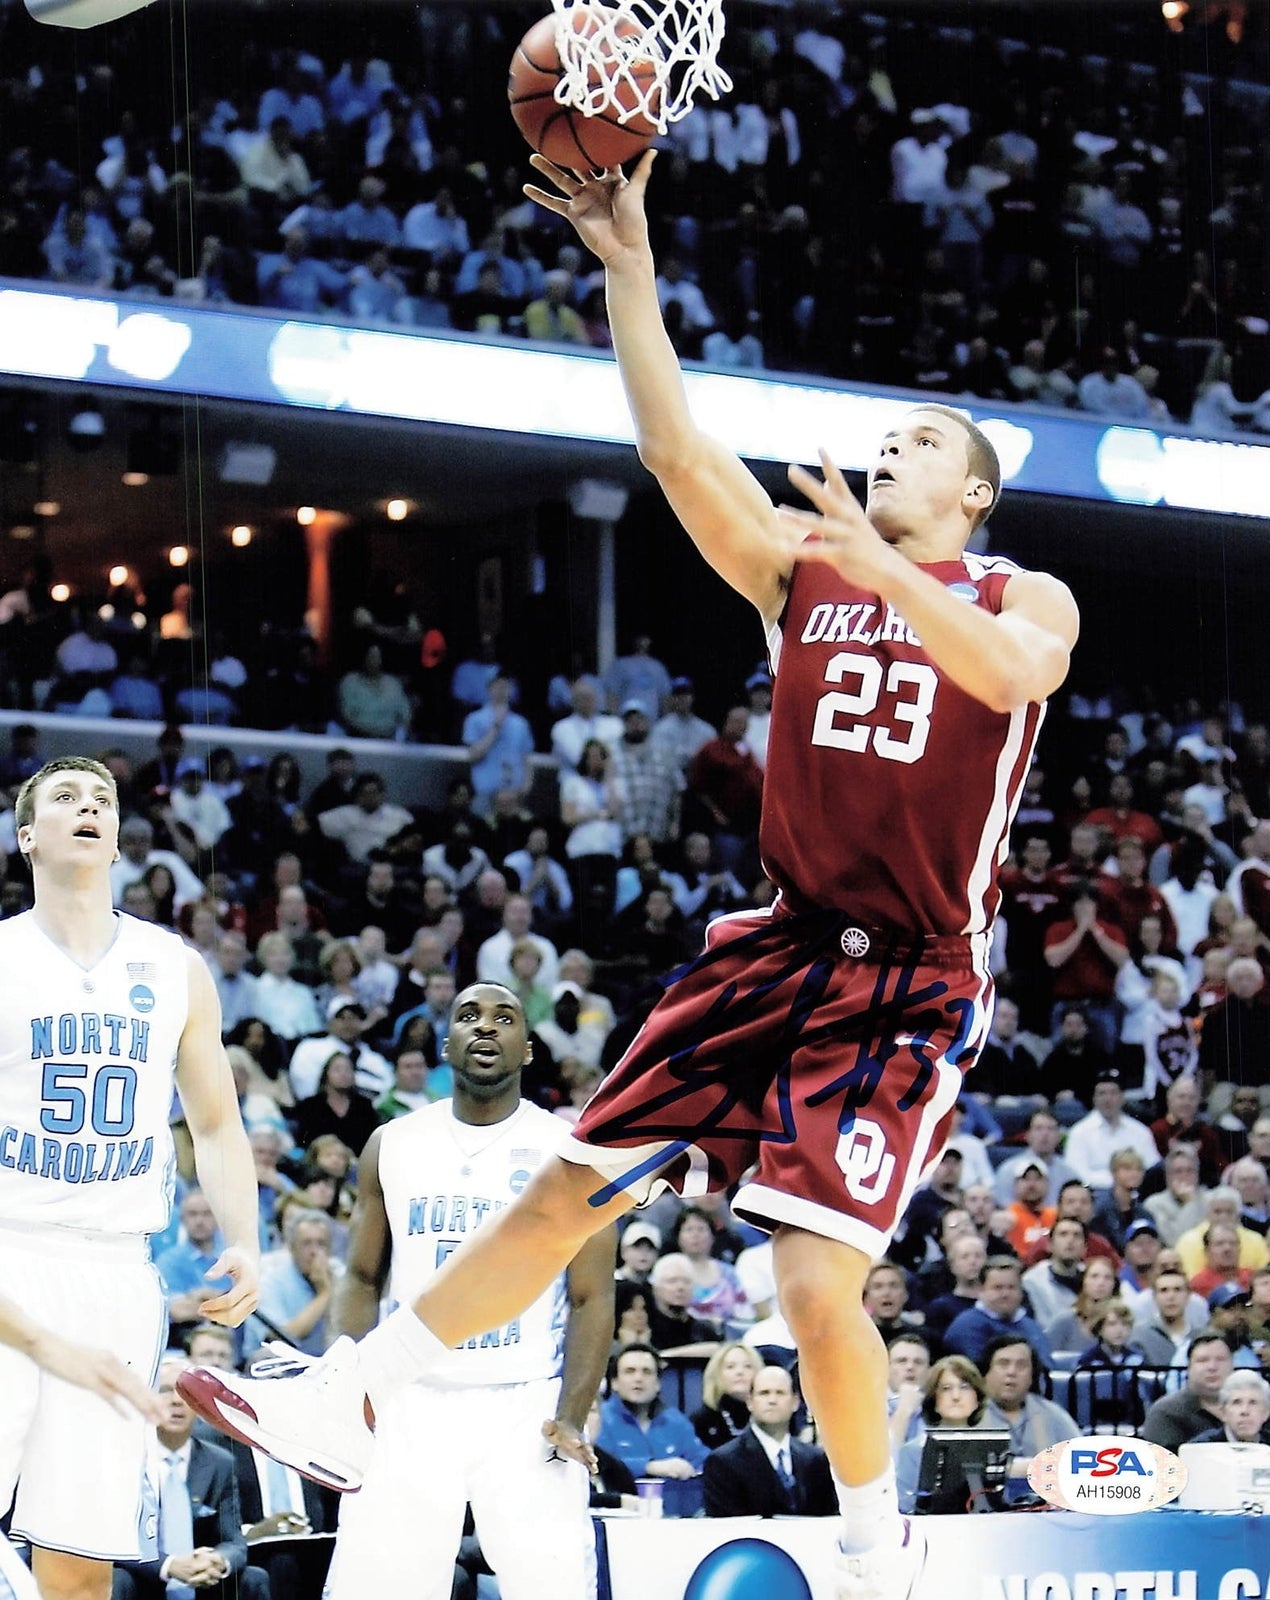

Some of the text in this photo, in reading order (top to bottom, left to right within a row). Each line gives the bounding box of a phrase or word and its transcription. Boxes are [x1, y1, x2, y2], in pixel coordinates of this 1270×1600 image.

[811, 652, 939, 764] 23
[31, 1013, 150, 1062] NORTH
[40, 1063, 137, 1136] 50
[0, 1126, 154, 1184] CAROLINA
[408, 1195, 508, 1236] NORT
